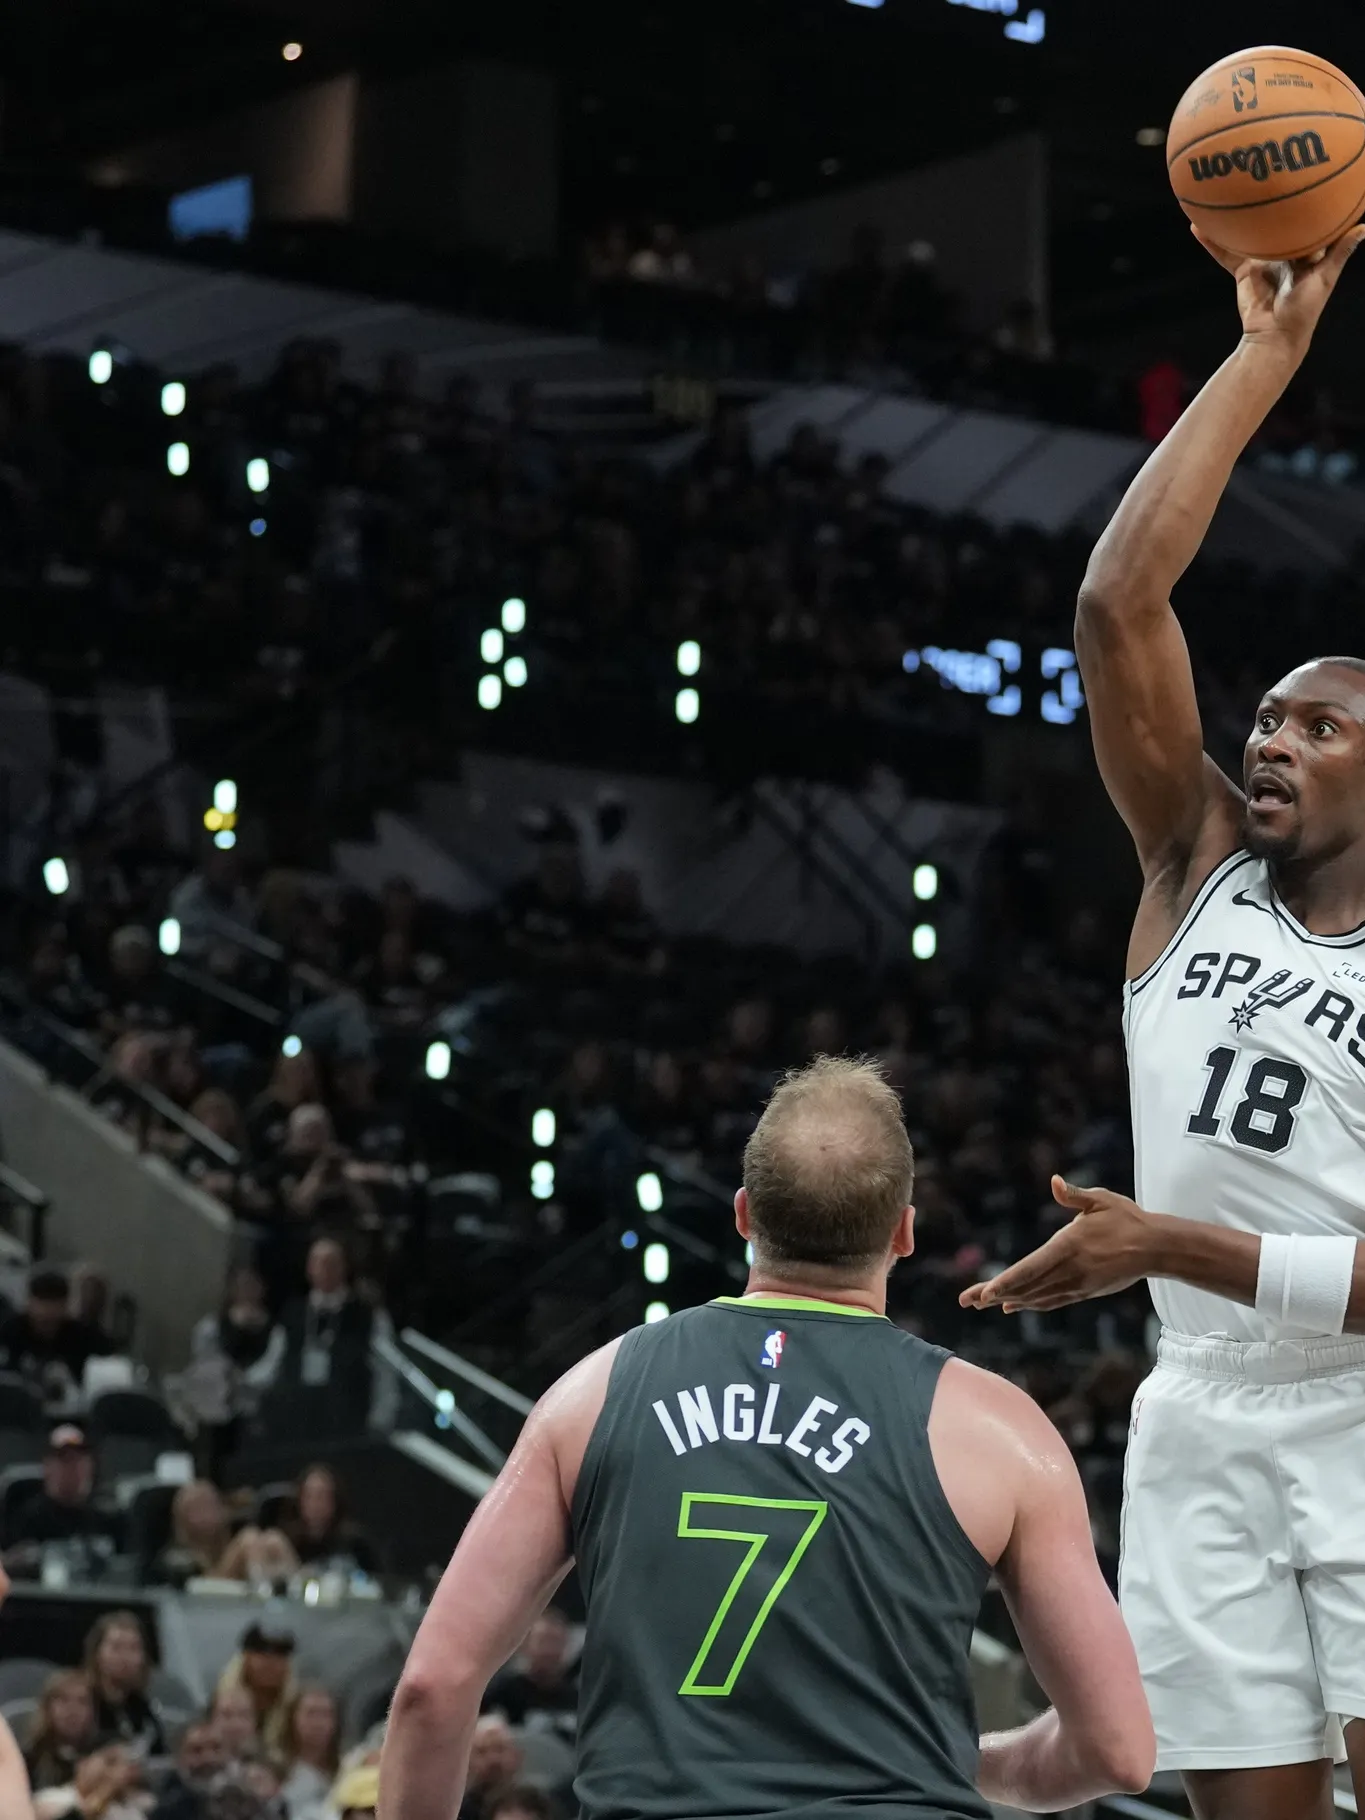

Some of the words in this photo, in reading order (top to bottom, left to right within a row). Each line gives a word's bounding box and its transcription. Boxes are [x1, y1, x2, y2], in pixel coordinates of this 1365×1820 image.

[1188, 129, 1331, 182] Wilson
[1185, 1044, 1314, 1157] 18
[652, 1383, 871, 1474] INGLES
[677, 1491, 829, 1696] 7
